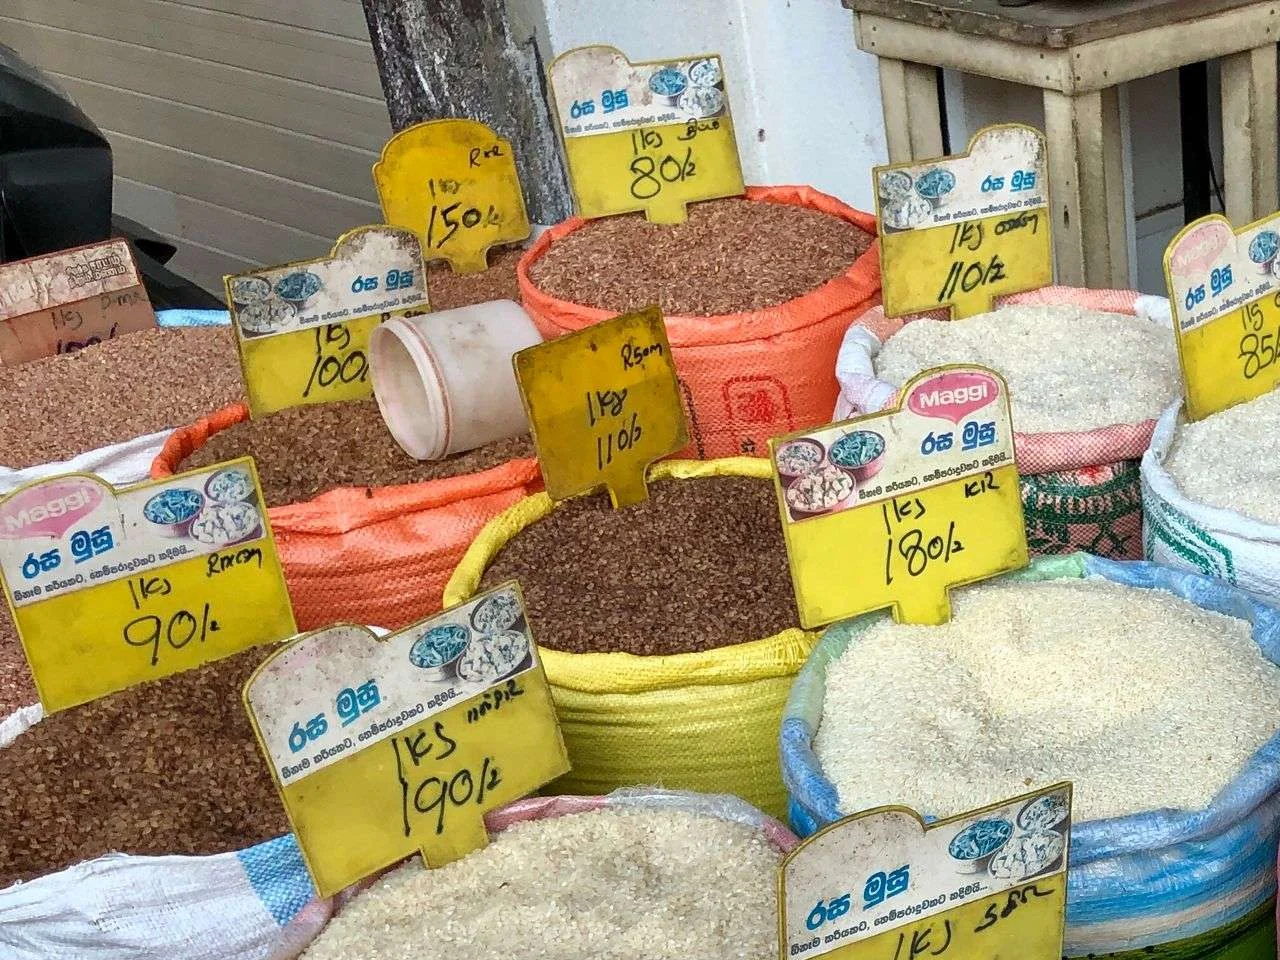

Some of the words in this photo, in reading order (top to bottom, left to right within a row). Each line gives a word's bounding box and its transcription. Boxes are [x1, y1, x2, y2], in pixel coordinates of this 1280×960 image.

[570, 99, 595, 119] රස
[980, 174, 1004, 193] රස
[919, 381, 988, 410] Maggi
[919, 431, 954, 457] රස
[961, 421, 998, 451] මුසු
[21, 549, 61, 580] රස
[70, 524, 115, 565] මුසු
[288, 712, 329, 753] රස
[336, 678, 383, 728] මුසු
[804, 893, 852, 932] රස
[862, 863, 911, 914] මුසු
